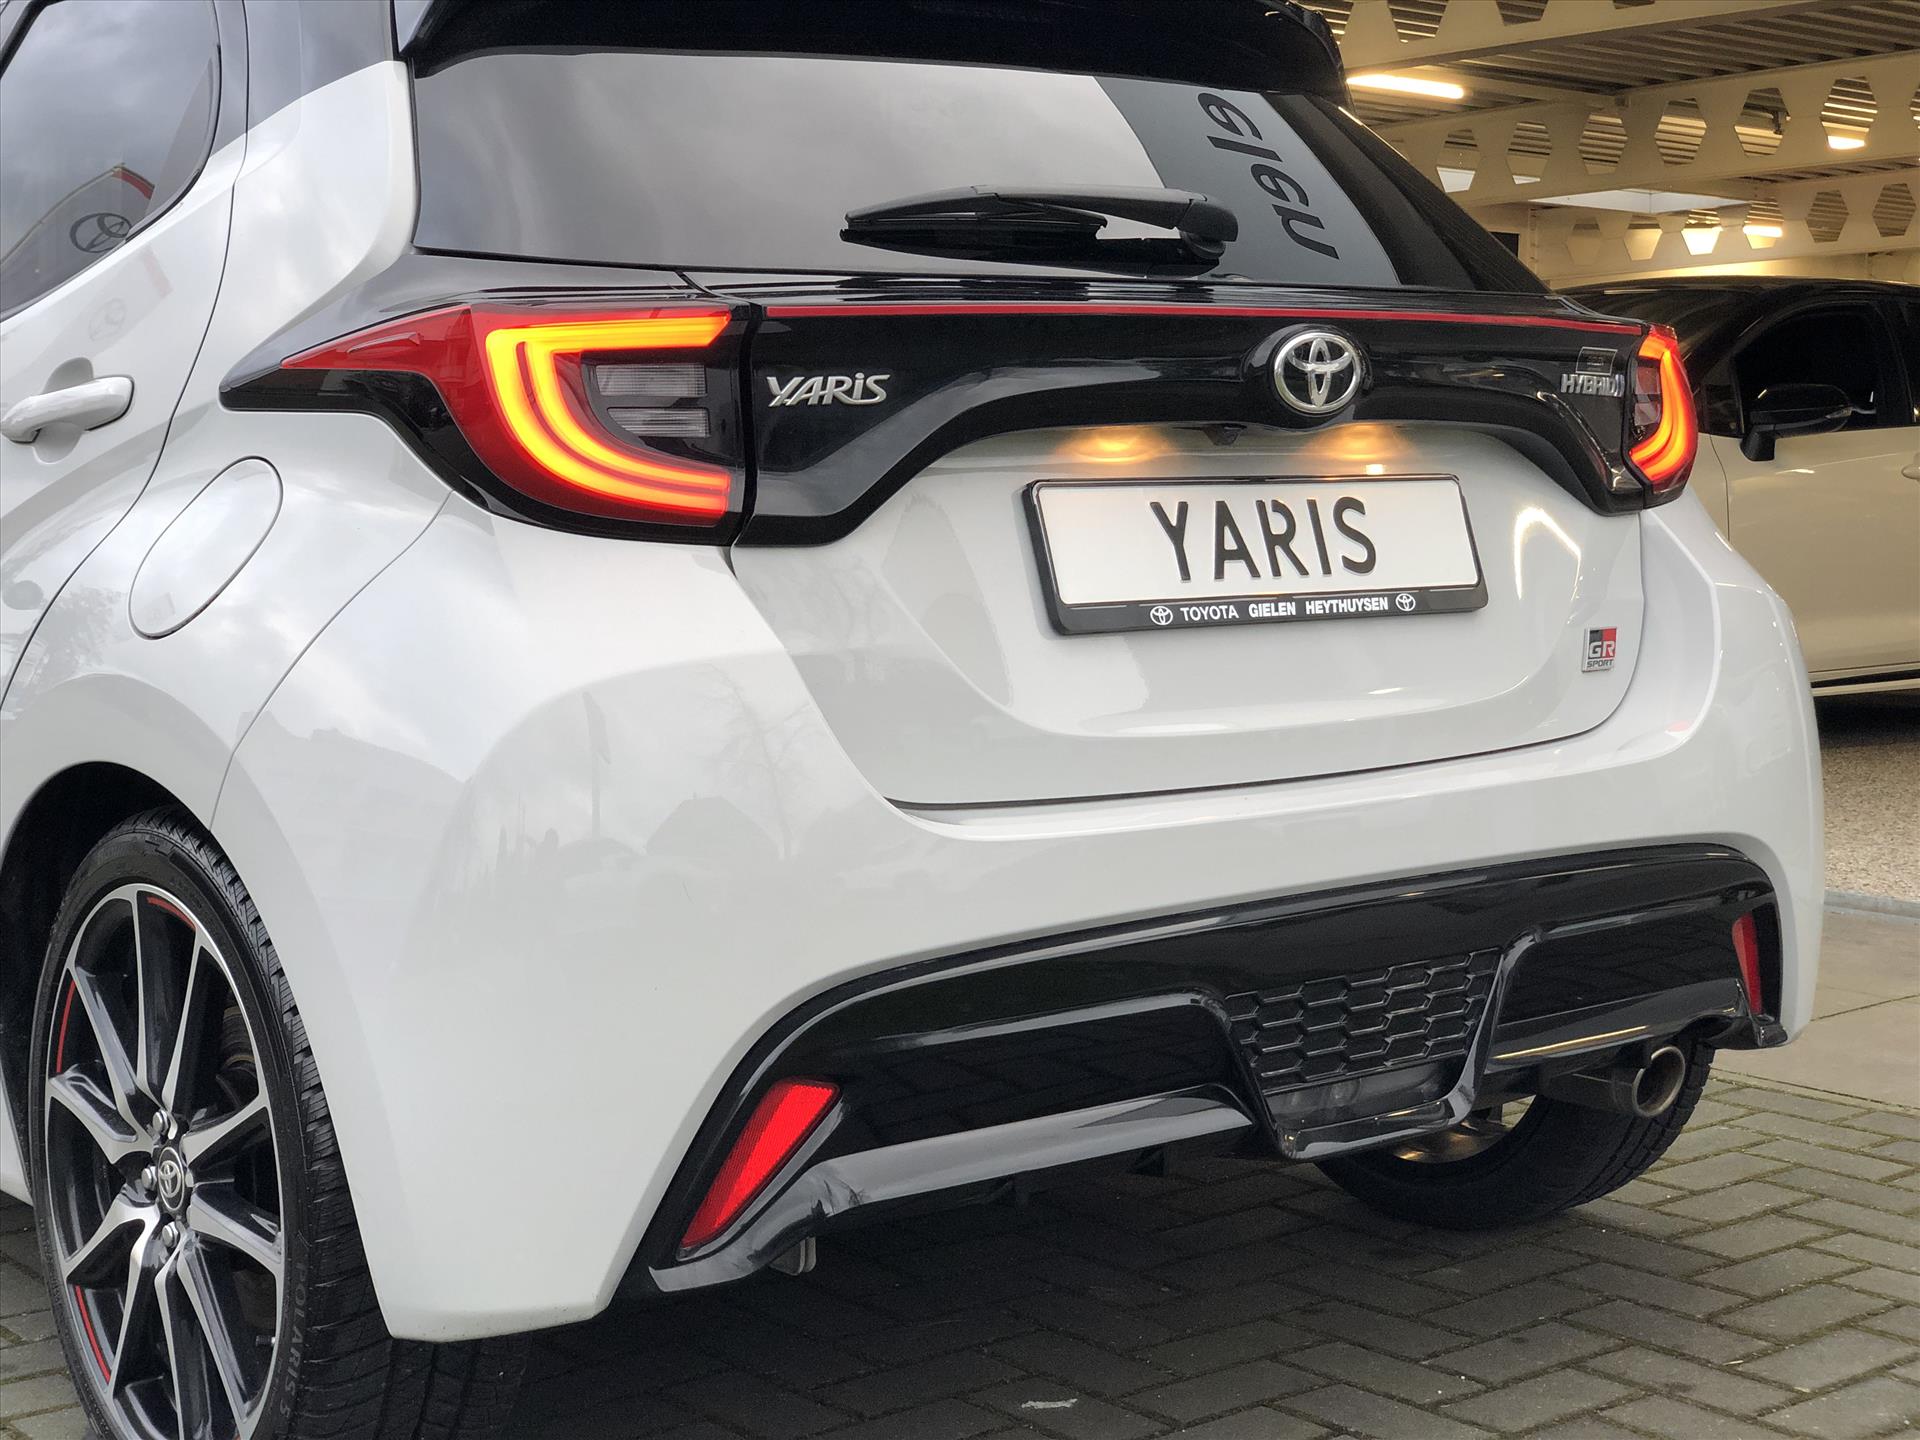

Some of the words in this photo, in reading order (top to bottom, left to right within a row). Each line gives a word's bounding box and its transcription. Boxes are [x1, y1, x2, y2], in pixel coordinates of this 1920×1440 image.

[1560, 373, 1618, 396] HYBRID
[1149, 496, 1377, 582] YARIS
[1180, 605, 1239, 621] TOYOTA
[1248, 602, 1296, 618] GIELEN
[1305, 597, 1389, 615] HEYTHUYSEN
[1588, 640, 1616, 658] GR
[1586, 659, 1614, 668] SPORT
[284, 1262, 308, 1396] POLARIS
